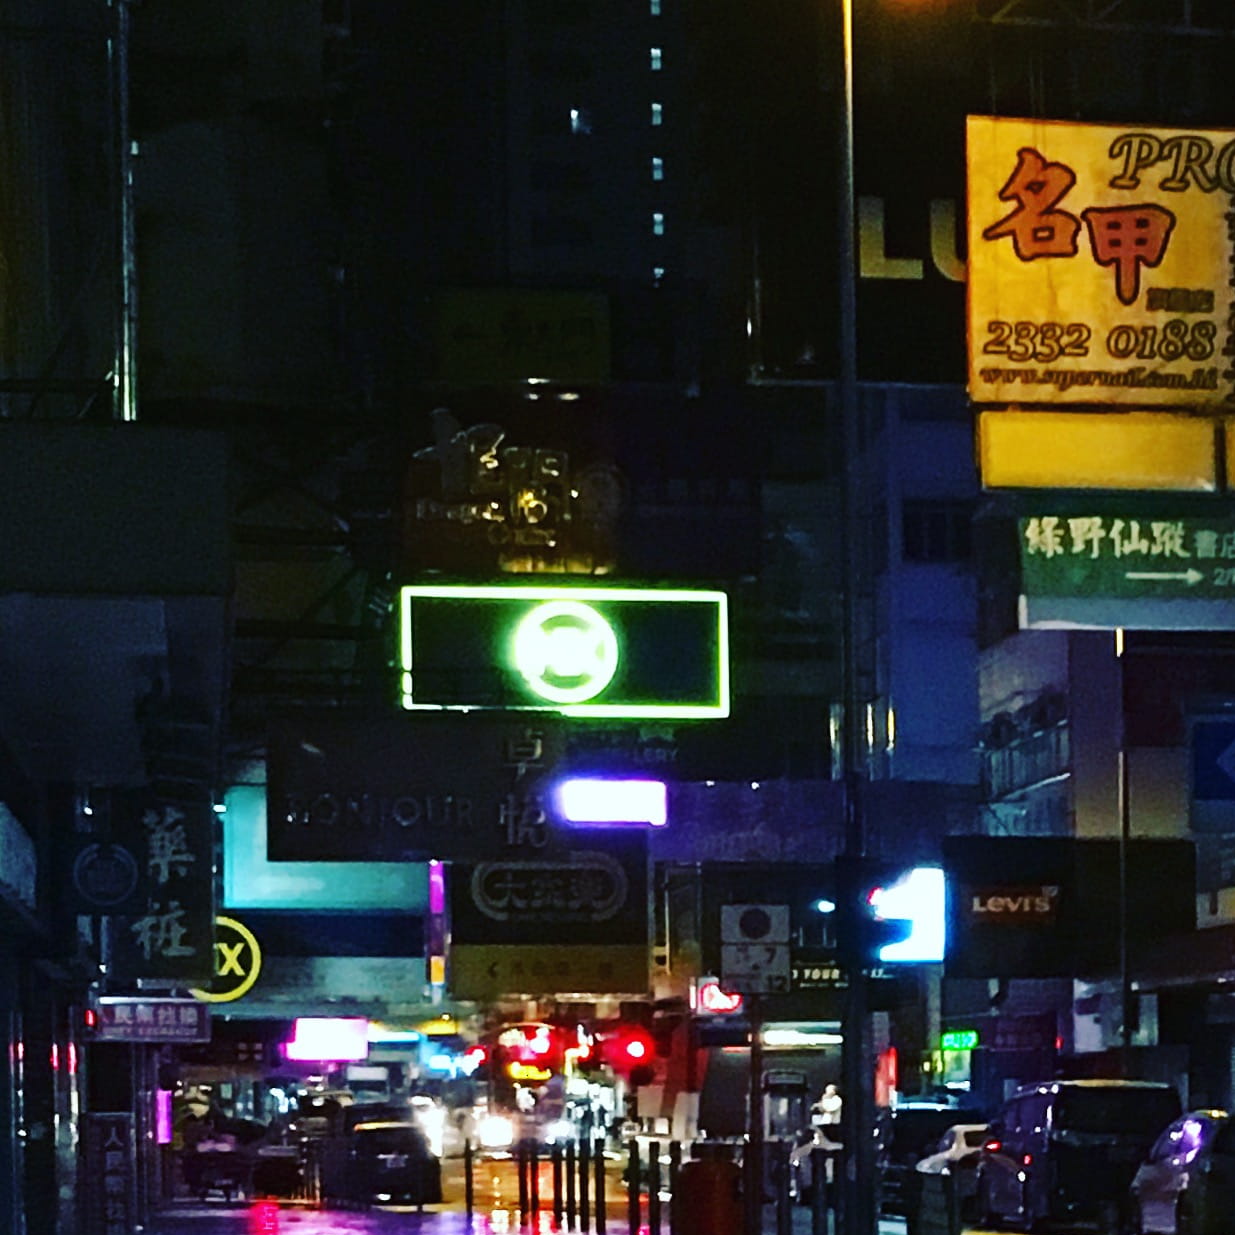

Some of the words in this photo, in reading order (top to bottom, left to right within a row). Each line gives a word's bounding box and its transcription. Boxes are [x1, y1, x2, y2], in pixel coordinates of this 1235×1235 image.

[982, 146, 1177, 306] 名甲
[982, 320, 1092, 363] 2332
[1105, 318, 1217, 361] 0188
